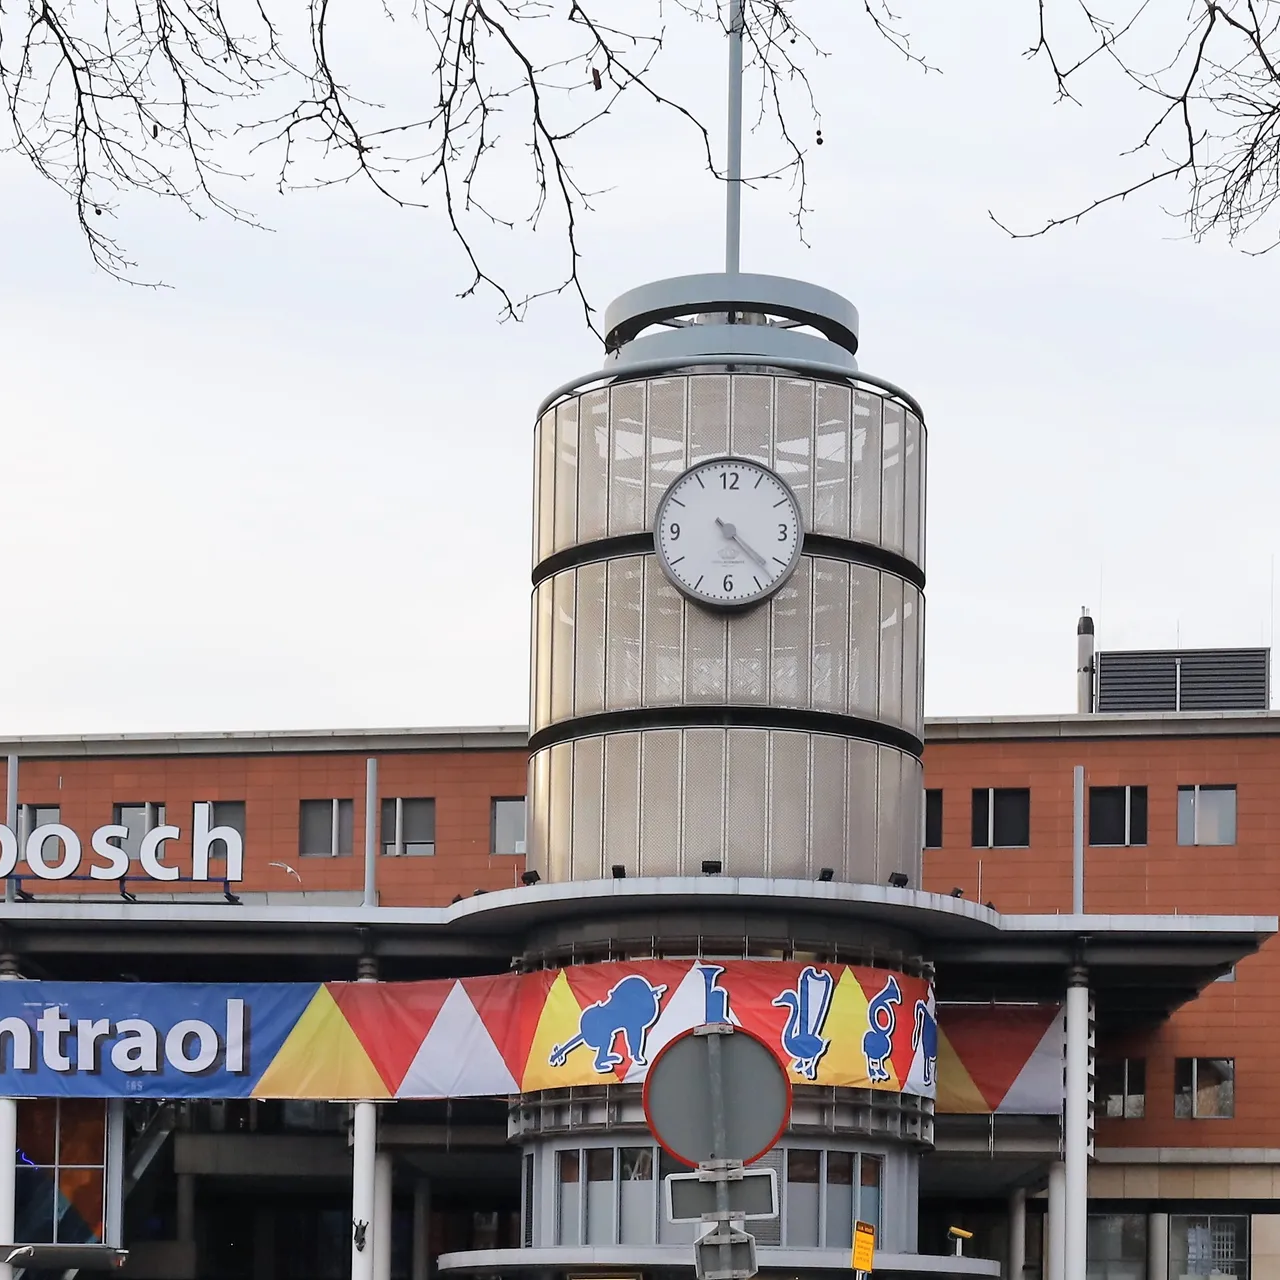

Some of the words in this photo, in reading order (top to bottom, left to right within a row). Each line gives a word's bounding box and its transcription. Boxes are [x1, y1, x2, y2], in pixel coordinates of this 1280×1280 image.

[719, 472, 740, 490] 12
[670, 523, 681, 541] 9
[777, 524, 788, 541] 3
[723, 574, 733, 592] 6
